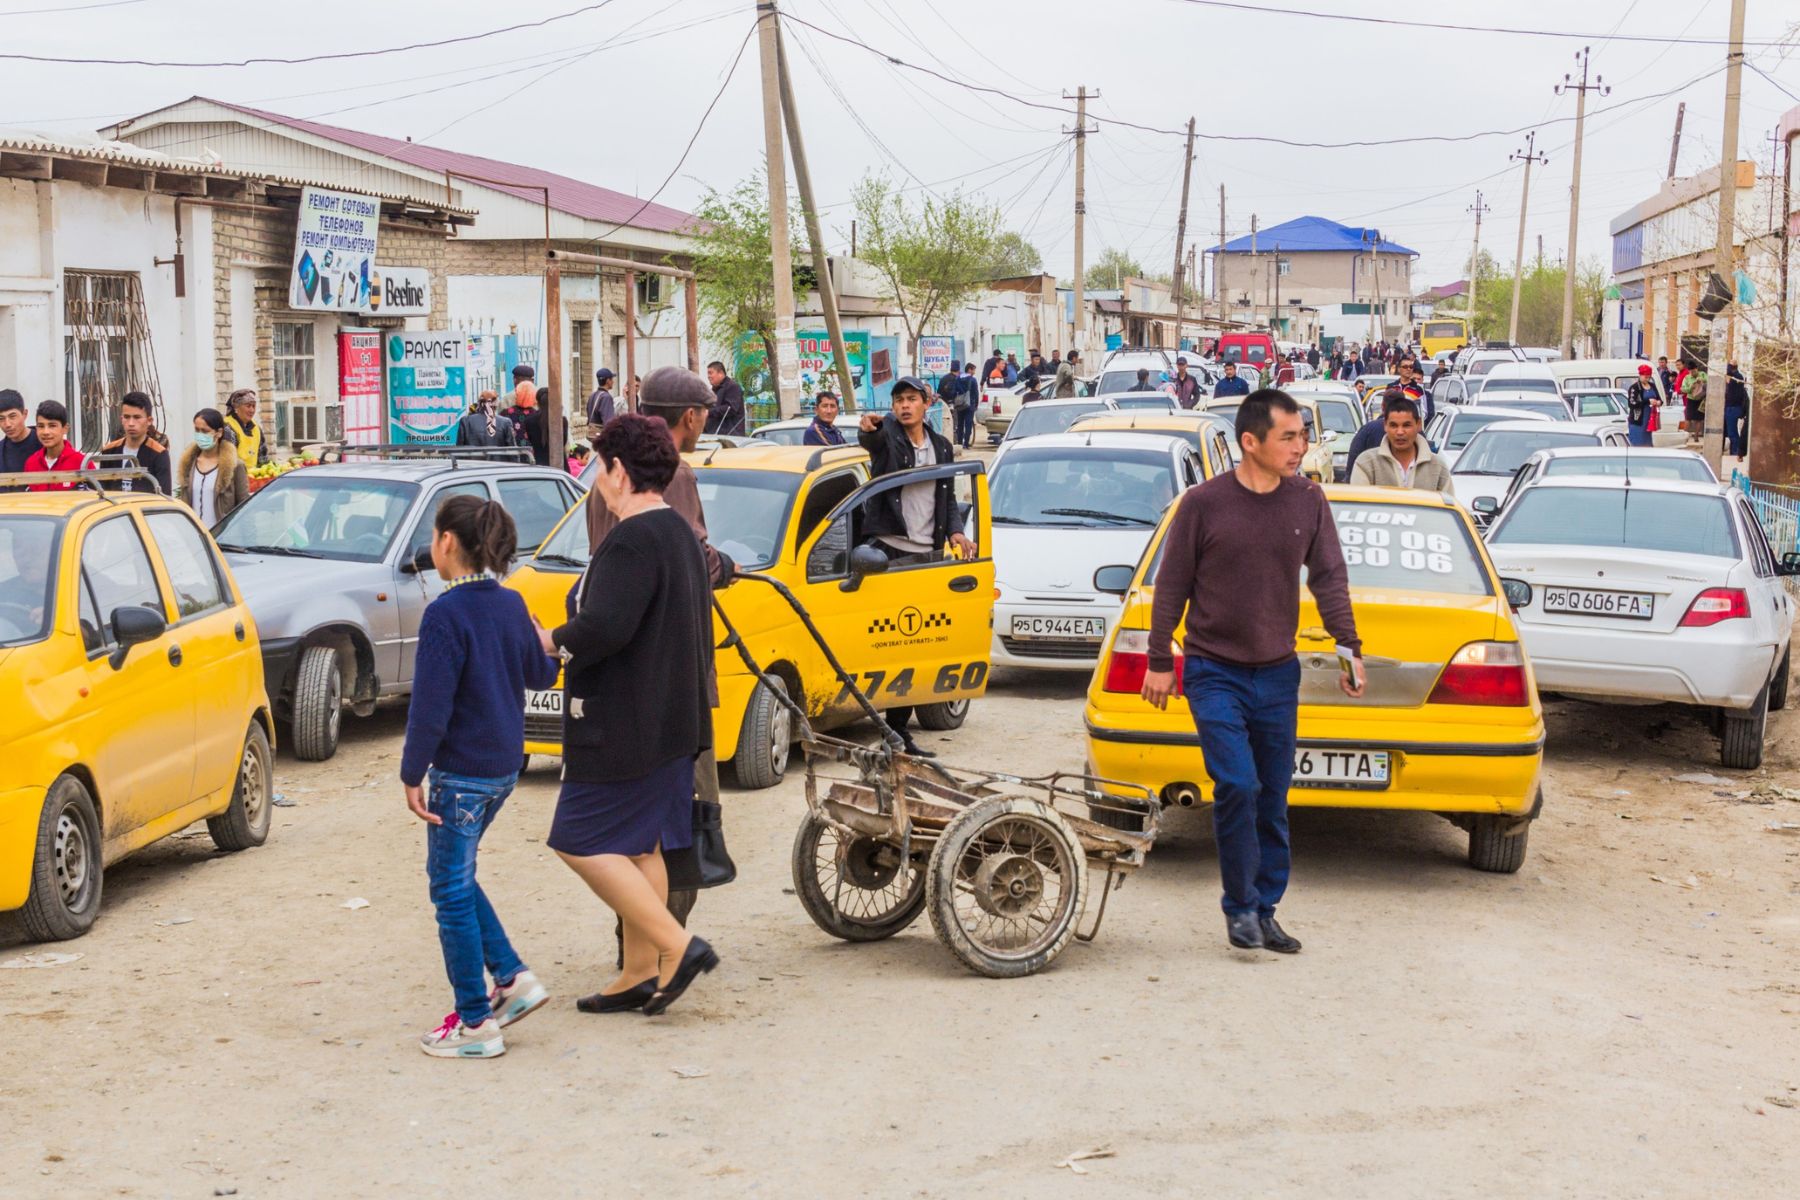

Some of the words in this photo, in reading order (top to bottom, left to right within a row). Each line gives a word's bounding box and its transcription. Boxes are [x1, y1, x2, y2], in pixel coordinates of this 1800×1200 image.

[309, 193, 340, 209] РЕМОНТ
[342, 199, 376, 215] СОТОВЫХ
[319, 215, 364, 232] ТЕЛЕФОНОВ
[302, 231, 328, 245] РЕМОНТ
[330, 234, 375, 251] КОМПЬЮТЕРОВ
[386, 277, 424, 307] Beeline
[405, 340, 461, 359] PAYNET
[1337, 510, 1417, 526] LION
[1340, 526, 1390, 546] 60
[1400, 531, 1451, 553] 06
[1342, 546, 1390, 567] 60
[1400, 550, 1453, 573] 06
[933, 661, 988, 694] 60
[531, 692, 561, 711] 440
[1322, 752, 1372, 778] TTA
